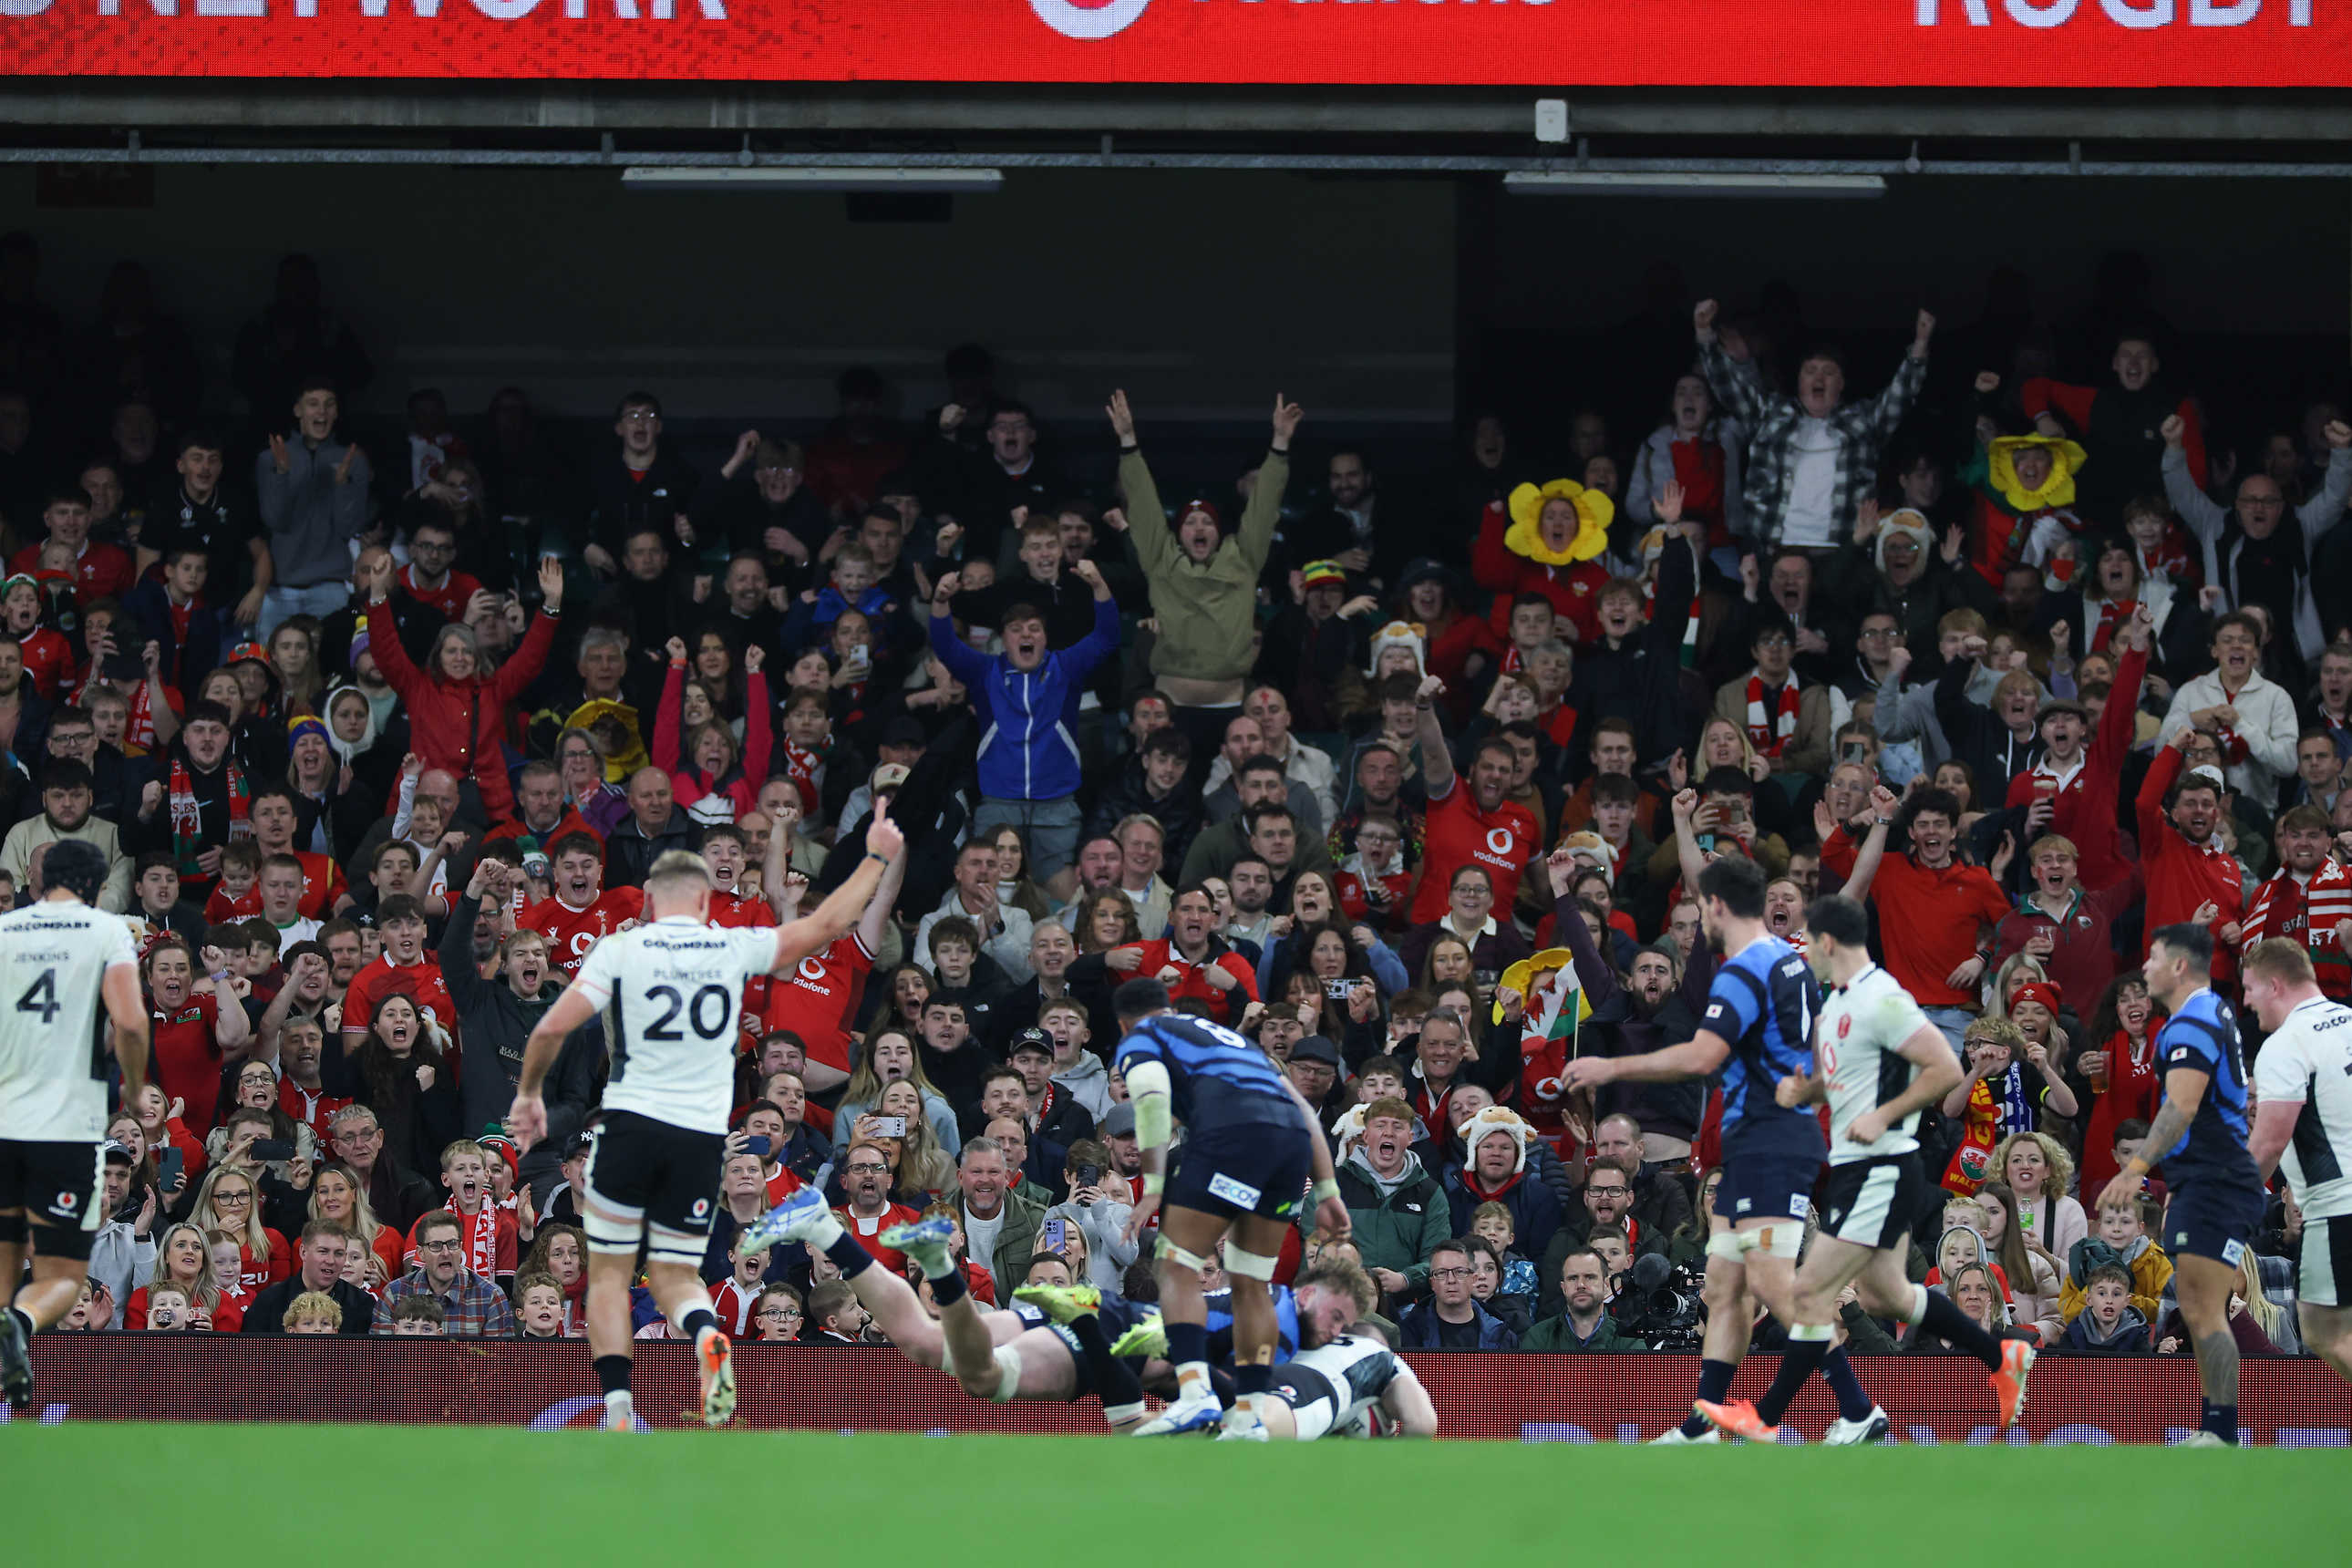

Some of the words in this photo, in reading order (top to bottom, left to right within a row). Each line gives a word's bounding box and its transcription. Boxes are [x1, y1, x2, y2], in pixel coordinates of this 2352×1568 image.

[1473, 850, 1516, 872] vodafone
[16, 967, 61, 1024] 4
[793, 976, 830, 996] odafone
[644, 985, 731, 1040] 20
